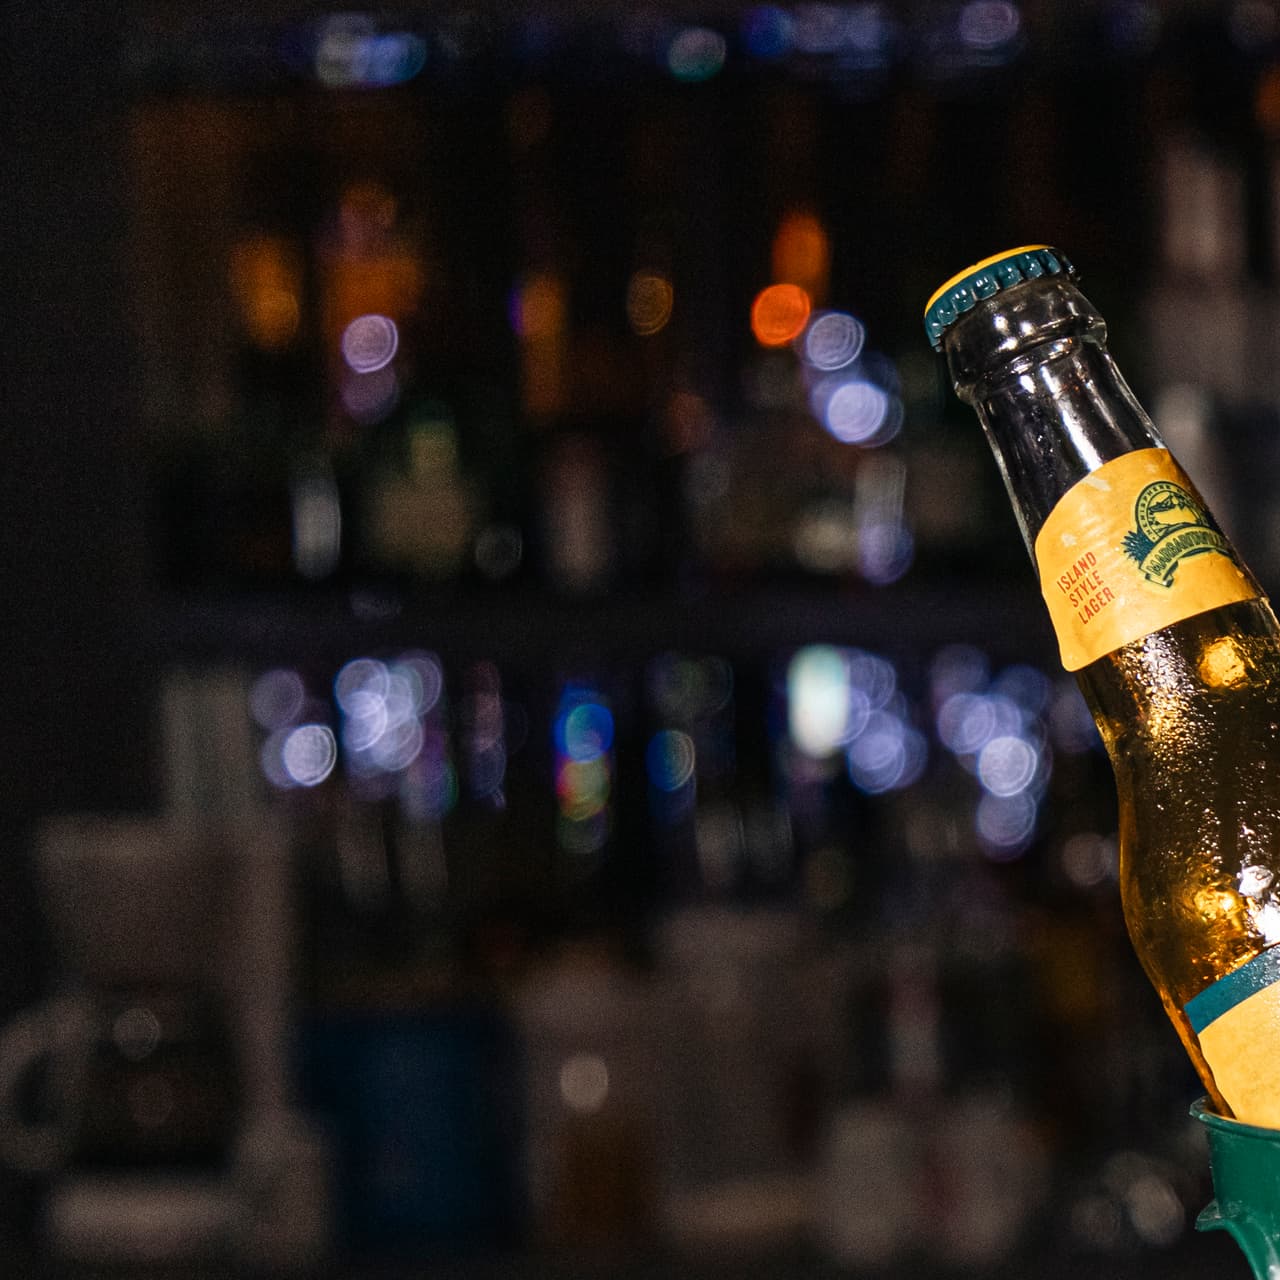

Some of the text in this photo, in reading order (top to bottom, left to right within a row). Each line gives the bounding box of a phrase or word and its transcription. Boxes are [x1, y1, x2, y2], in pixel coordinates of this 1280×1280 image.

[1057, 552, 1097, 593] ISLAND
[1070, 571, 1104, 608] STYLE
[1078, 587, 1115, 624] LAGER
